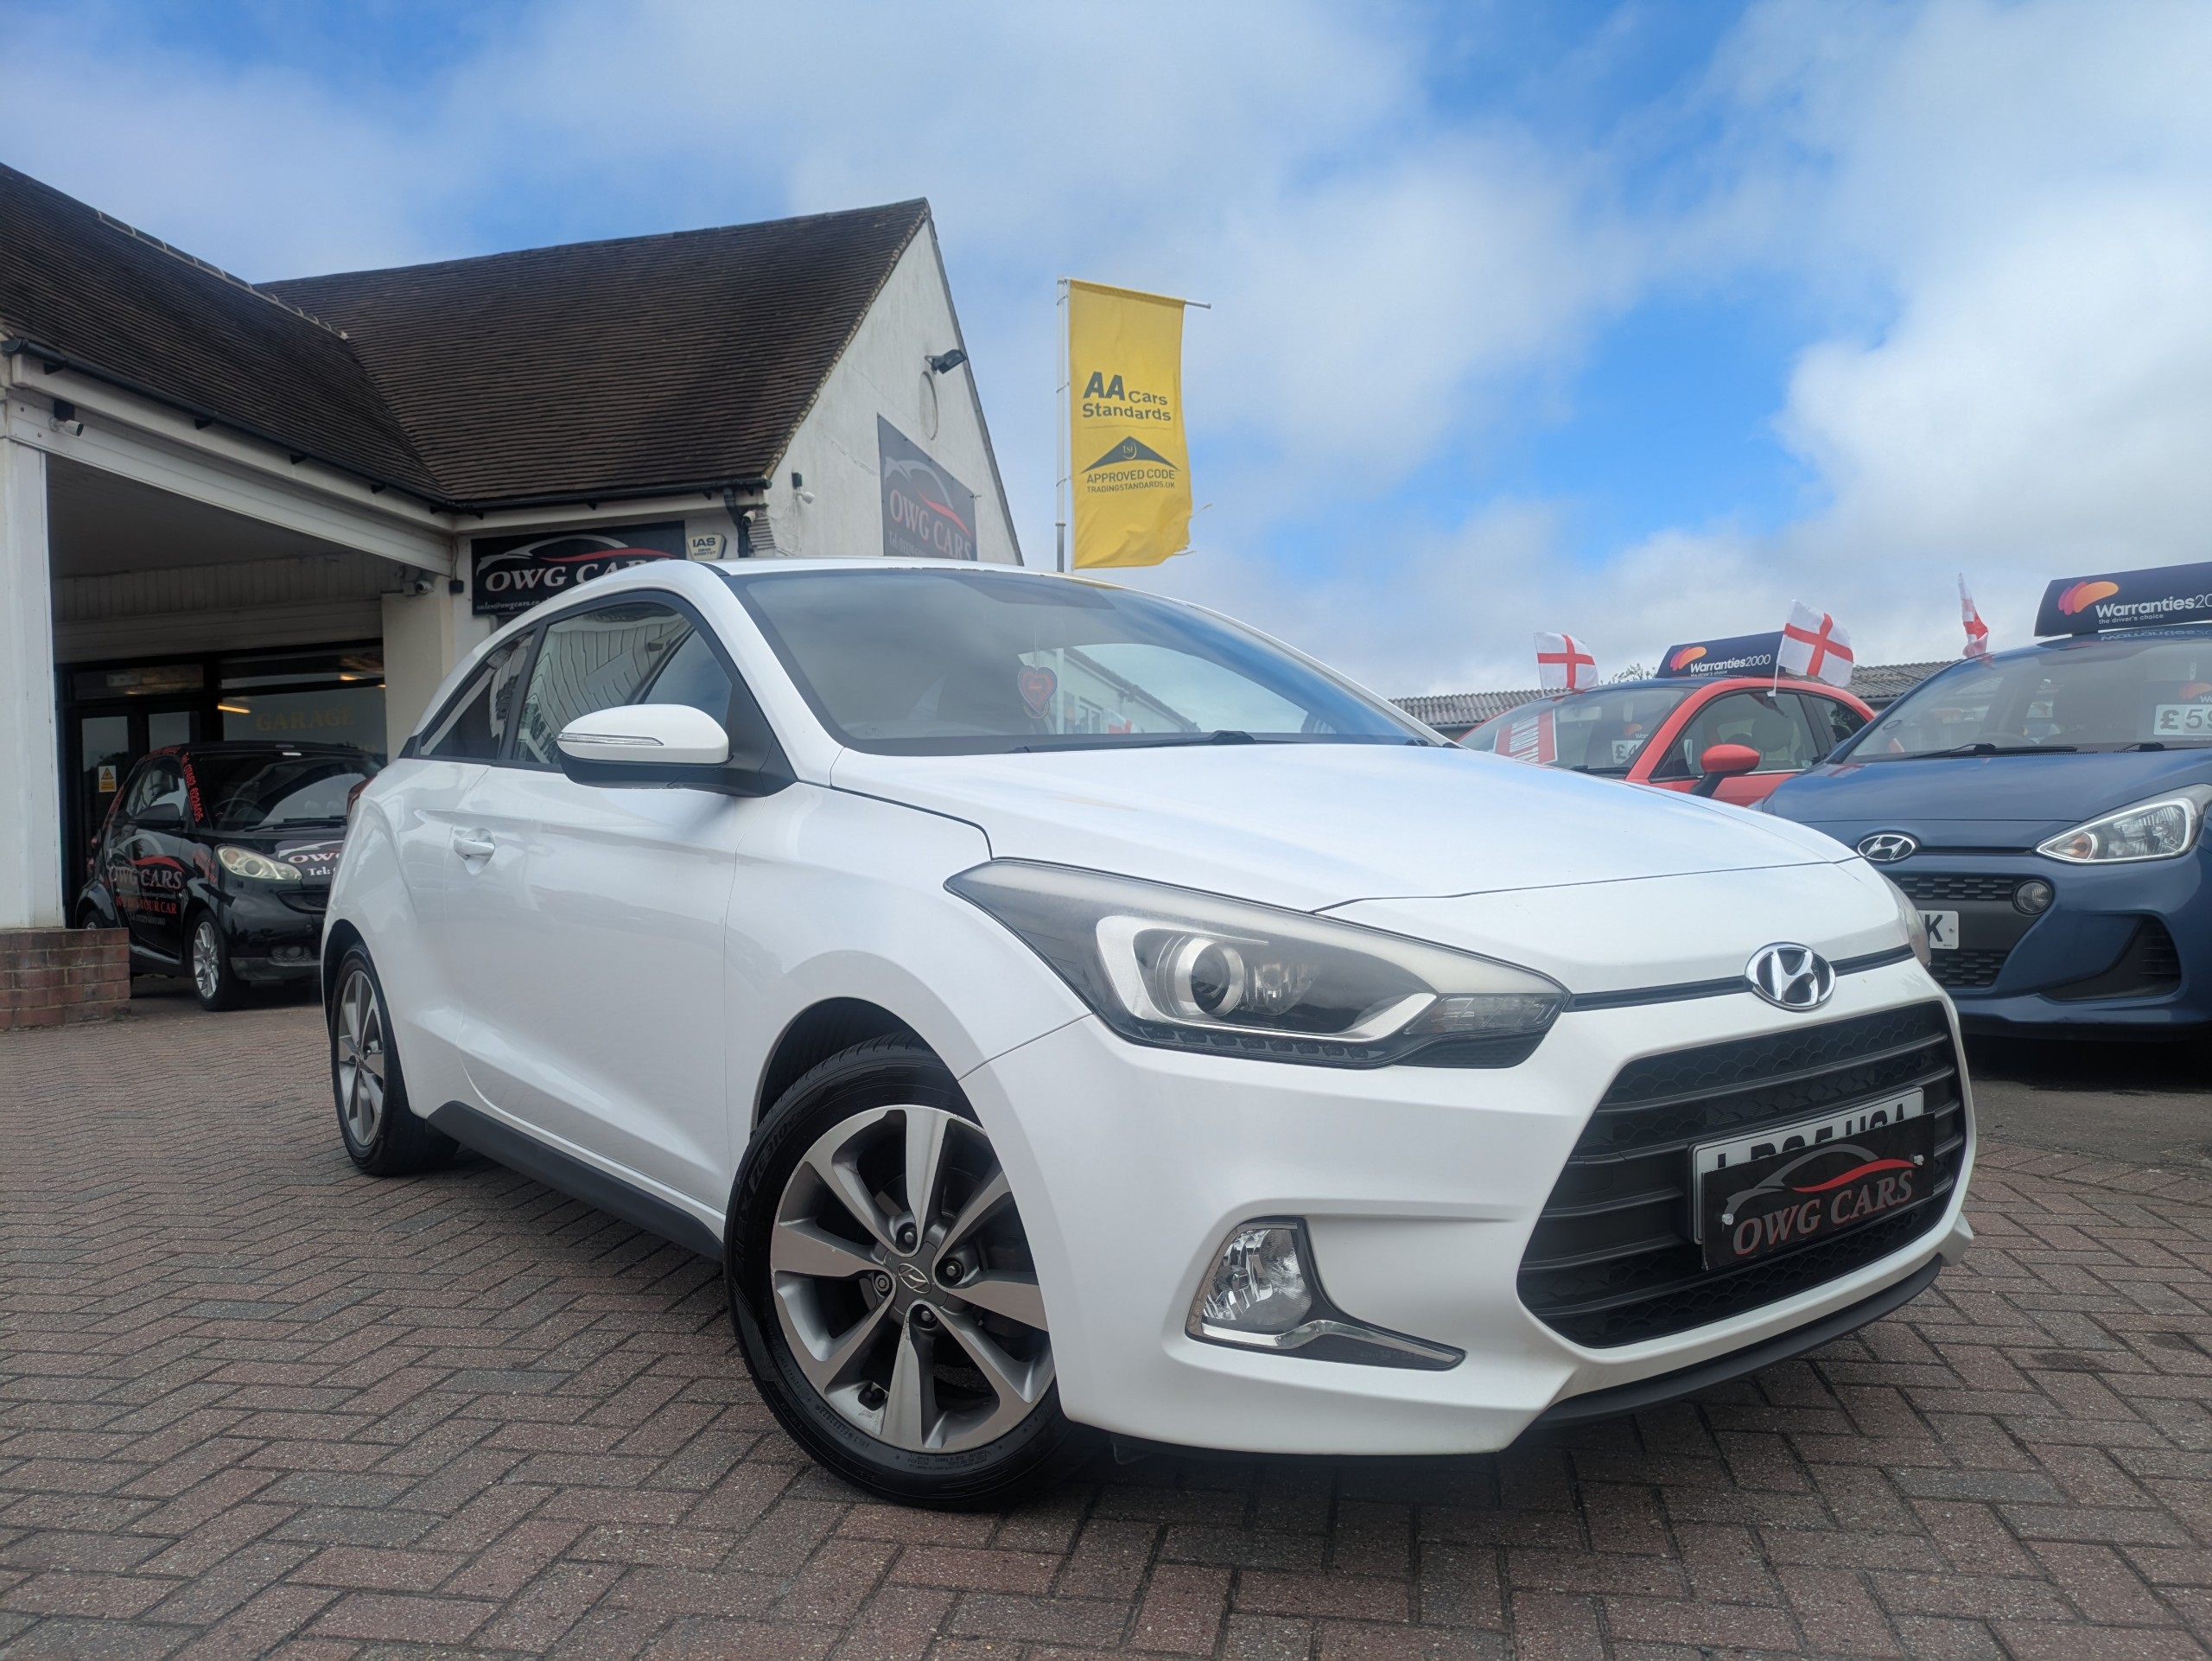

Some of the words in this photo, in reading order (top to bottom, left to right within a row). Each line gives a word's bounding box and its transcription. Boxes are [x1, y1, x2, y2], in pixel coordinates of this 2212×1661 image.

[1083, 371, 1125, 402] AA
[1128, 391, 1167, 405] Cars
[1082, 402, 1172, 421] Standards
[1086, 468, 1145, 484] APPROVED
[1147, 468, 1175, 480] CODE
[1086, 480, 1175, 493] TRADINGSTANDARDS.UK
[889, 489, 930, 543] OWG
[933, 519, 973, 560] CARS
[692, 537, 716, 548] IAS
[485, 566, 568, 592] OWG
[2112, 614, 2138, 624] driver's
[2139, 612, 2164, 621] choice
[1690, 653, 1771, 673] Warranties2000
[255, 706, 356, 732] GARAGE
[140, 869, 183, 890] CARS
[308, 866, 331, 876] Tel:
[140, 898, 160, 913] YOUR
[160, 901, 177, 914] CAR
[1733, 1199, 1822, 1256] OWG
[1830, 1169, 1913, 1225] CARS
